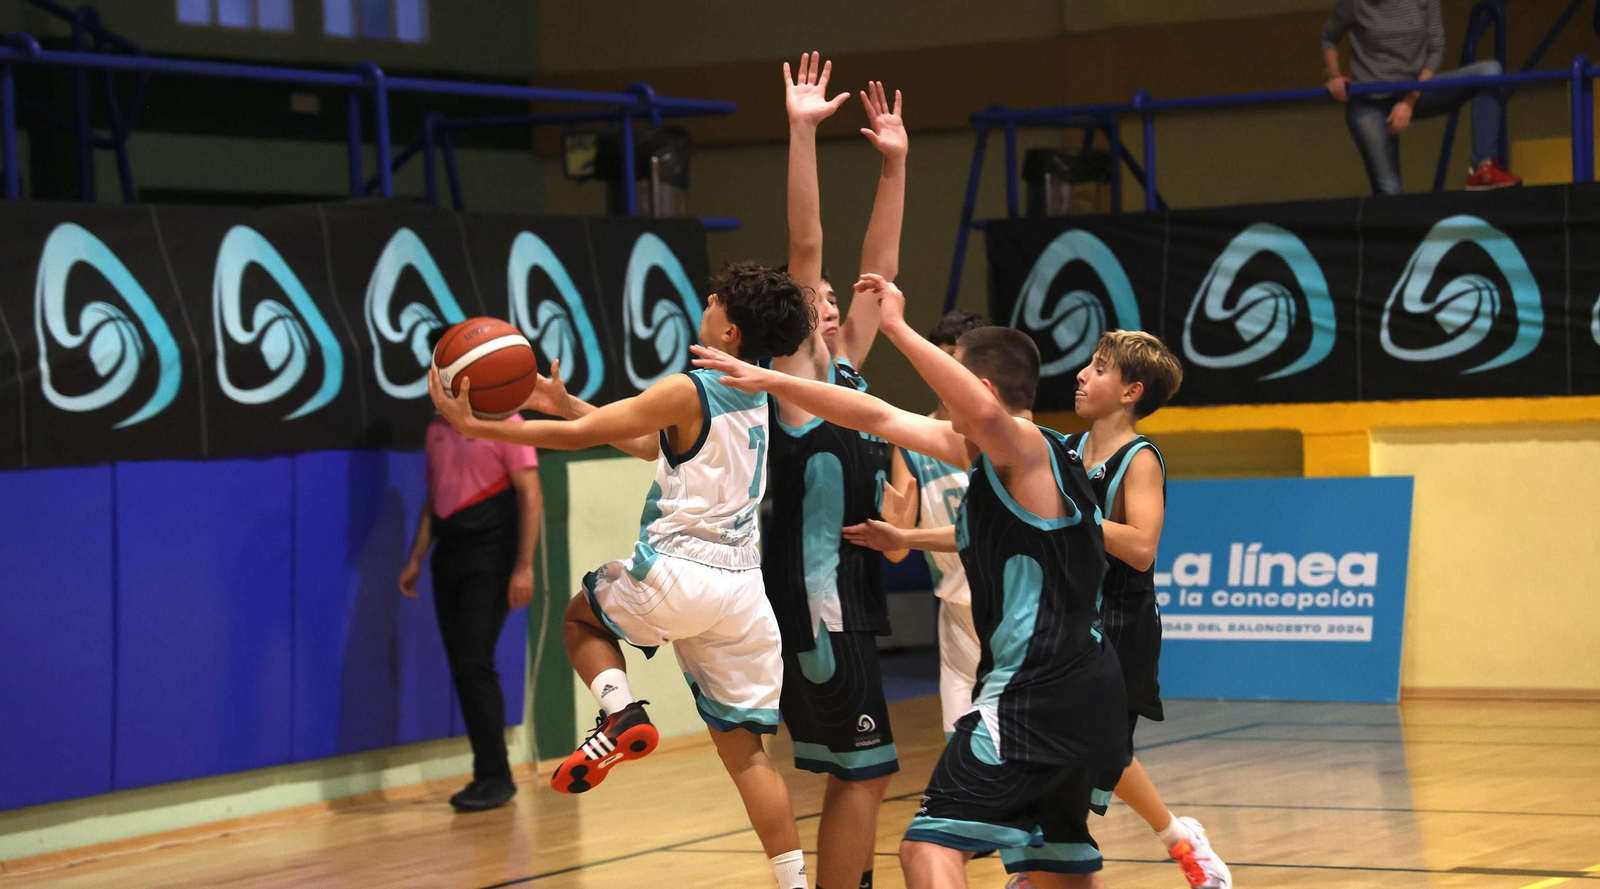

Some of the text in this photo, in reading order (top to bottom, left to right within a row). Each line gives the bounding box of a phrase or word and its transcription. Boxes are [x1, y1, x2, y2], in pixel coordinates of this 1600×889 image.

[748, 425, 766, 499] 7
[1228, 542, 1379, 587] línea
[1156, 588, 1374, 611] e la Concepción
[1162, 622, 1192, 632] DAD
[1198, 622, 1222, 632] DEL
[1327, 624, 1365, 634] 2024
